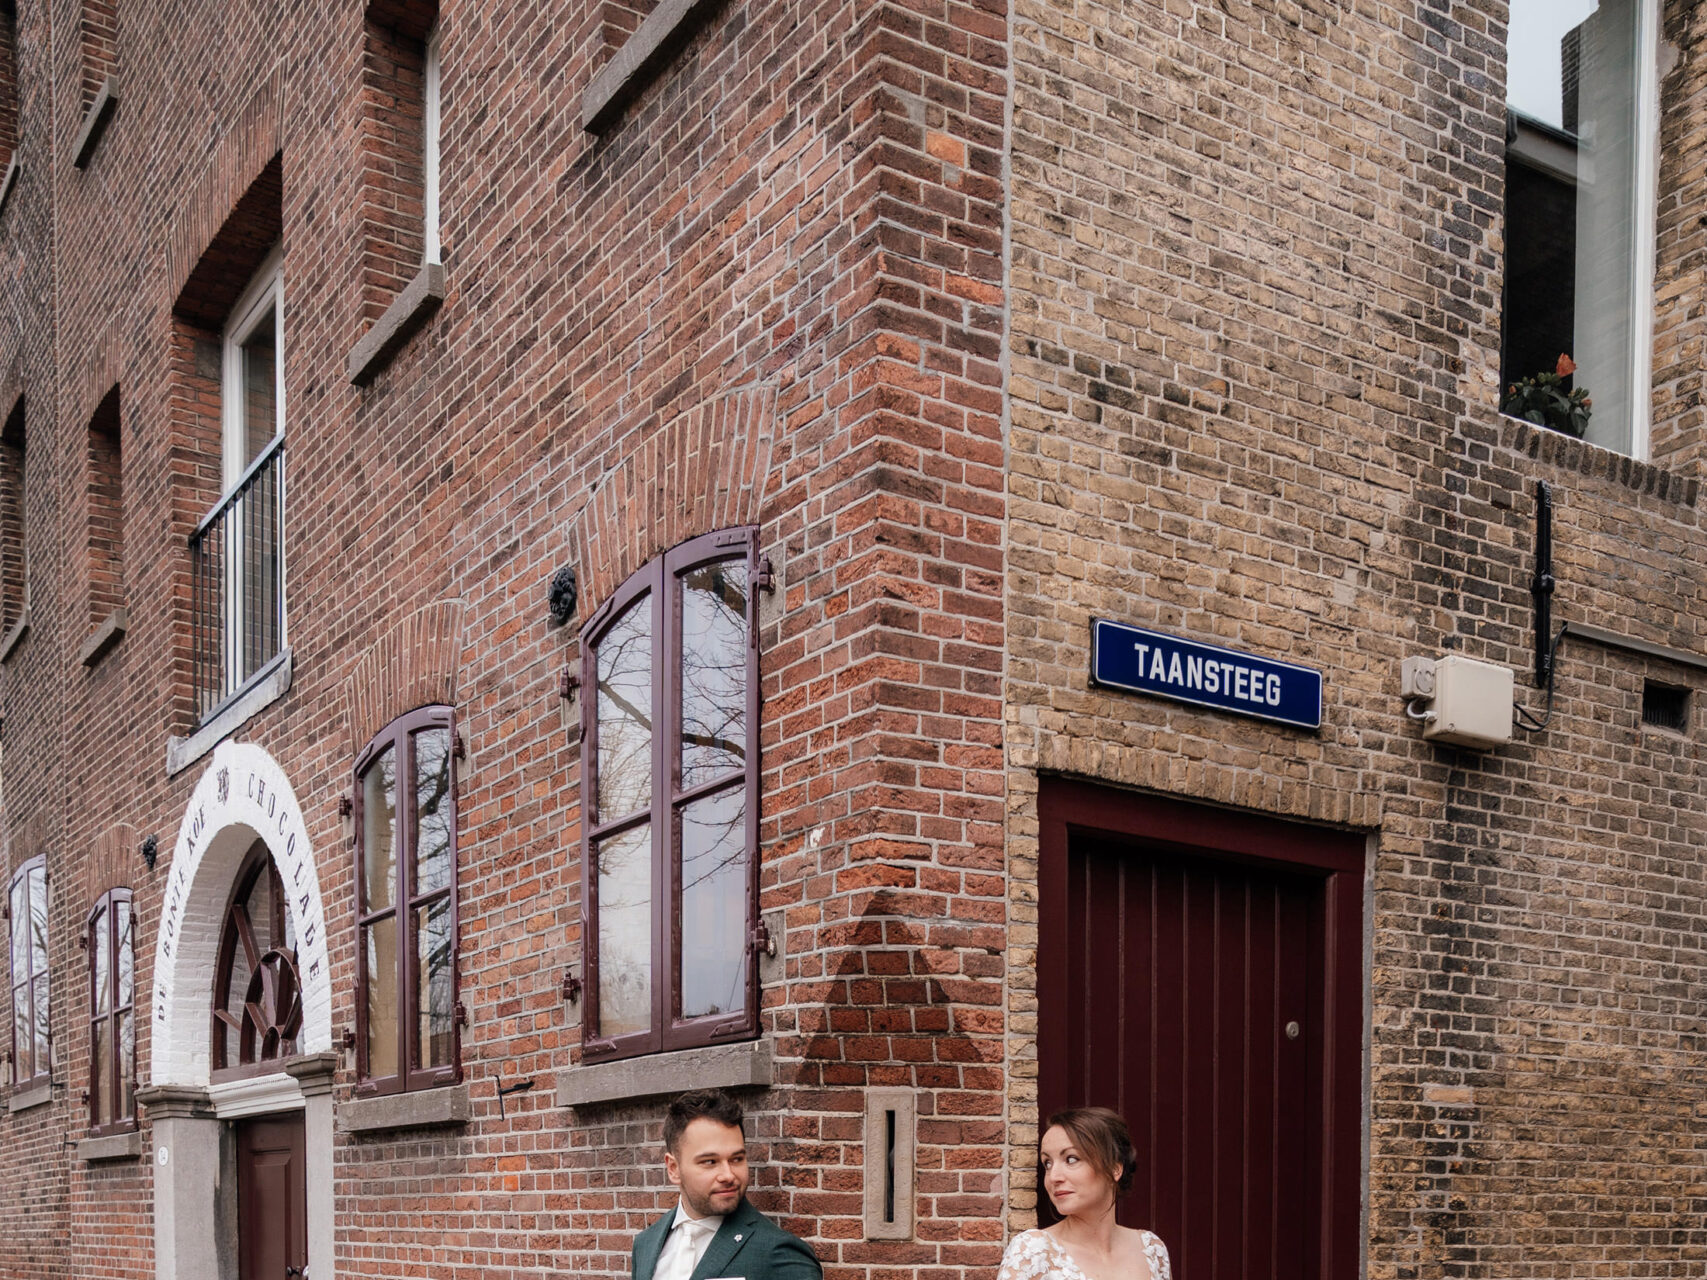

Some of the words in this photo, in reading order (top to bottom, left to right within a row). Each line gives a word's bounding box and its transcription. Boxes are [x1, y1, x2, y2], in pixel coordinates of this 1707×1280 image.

[1134, 643, 1281, 707] TAANSTEEG
[158, 983, 167, 1021] DE
[248, 772, 320, 982] CHOCOLADE
